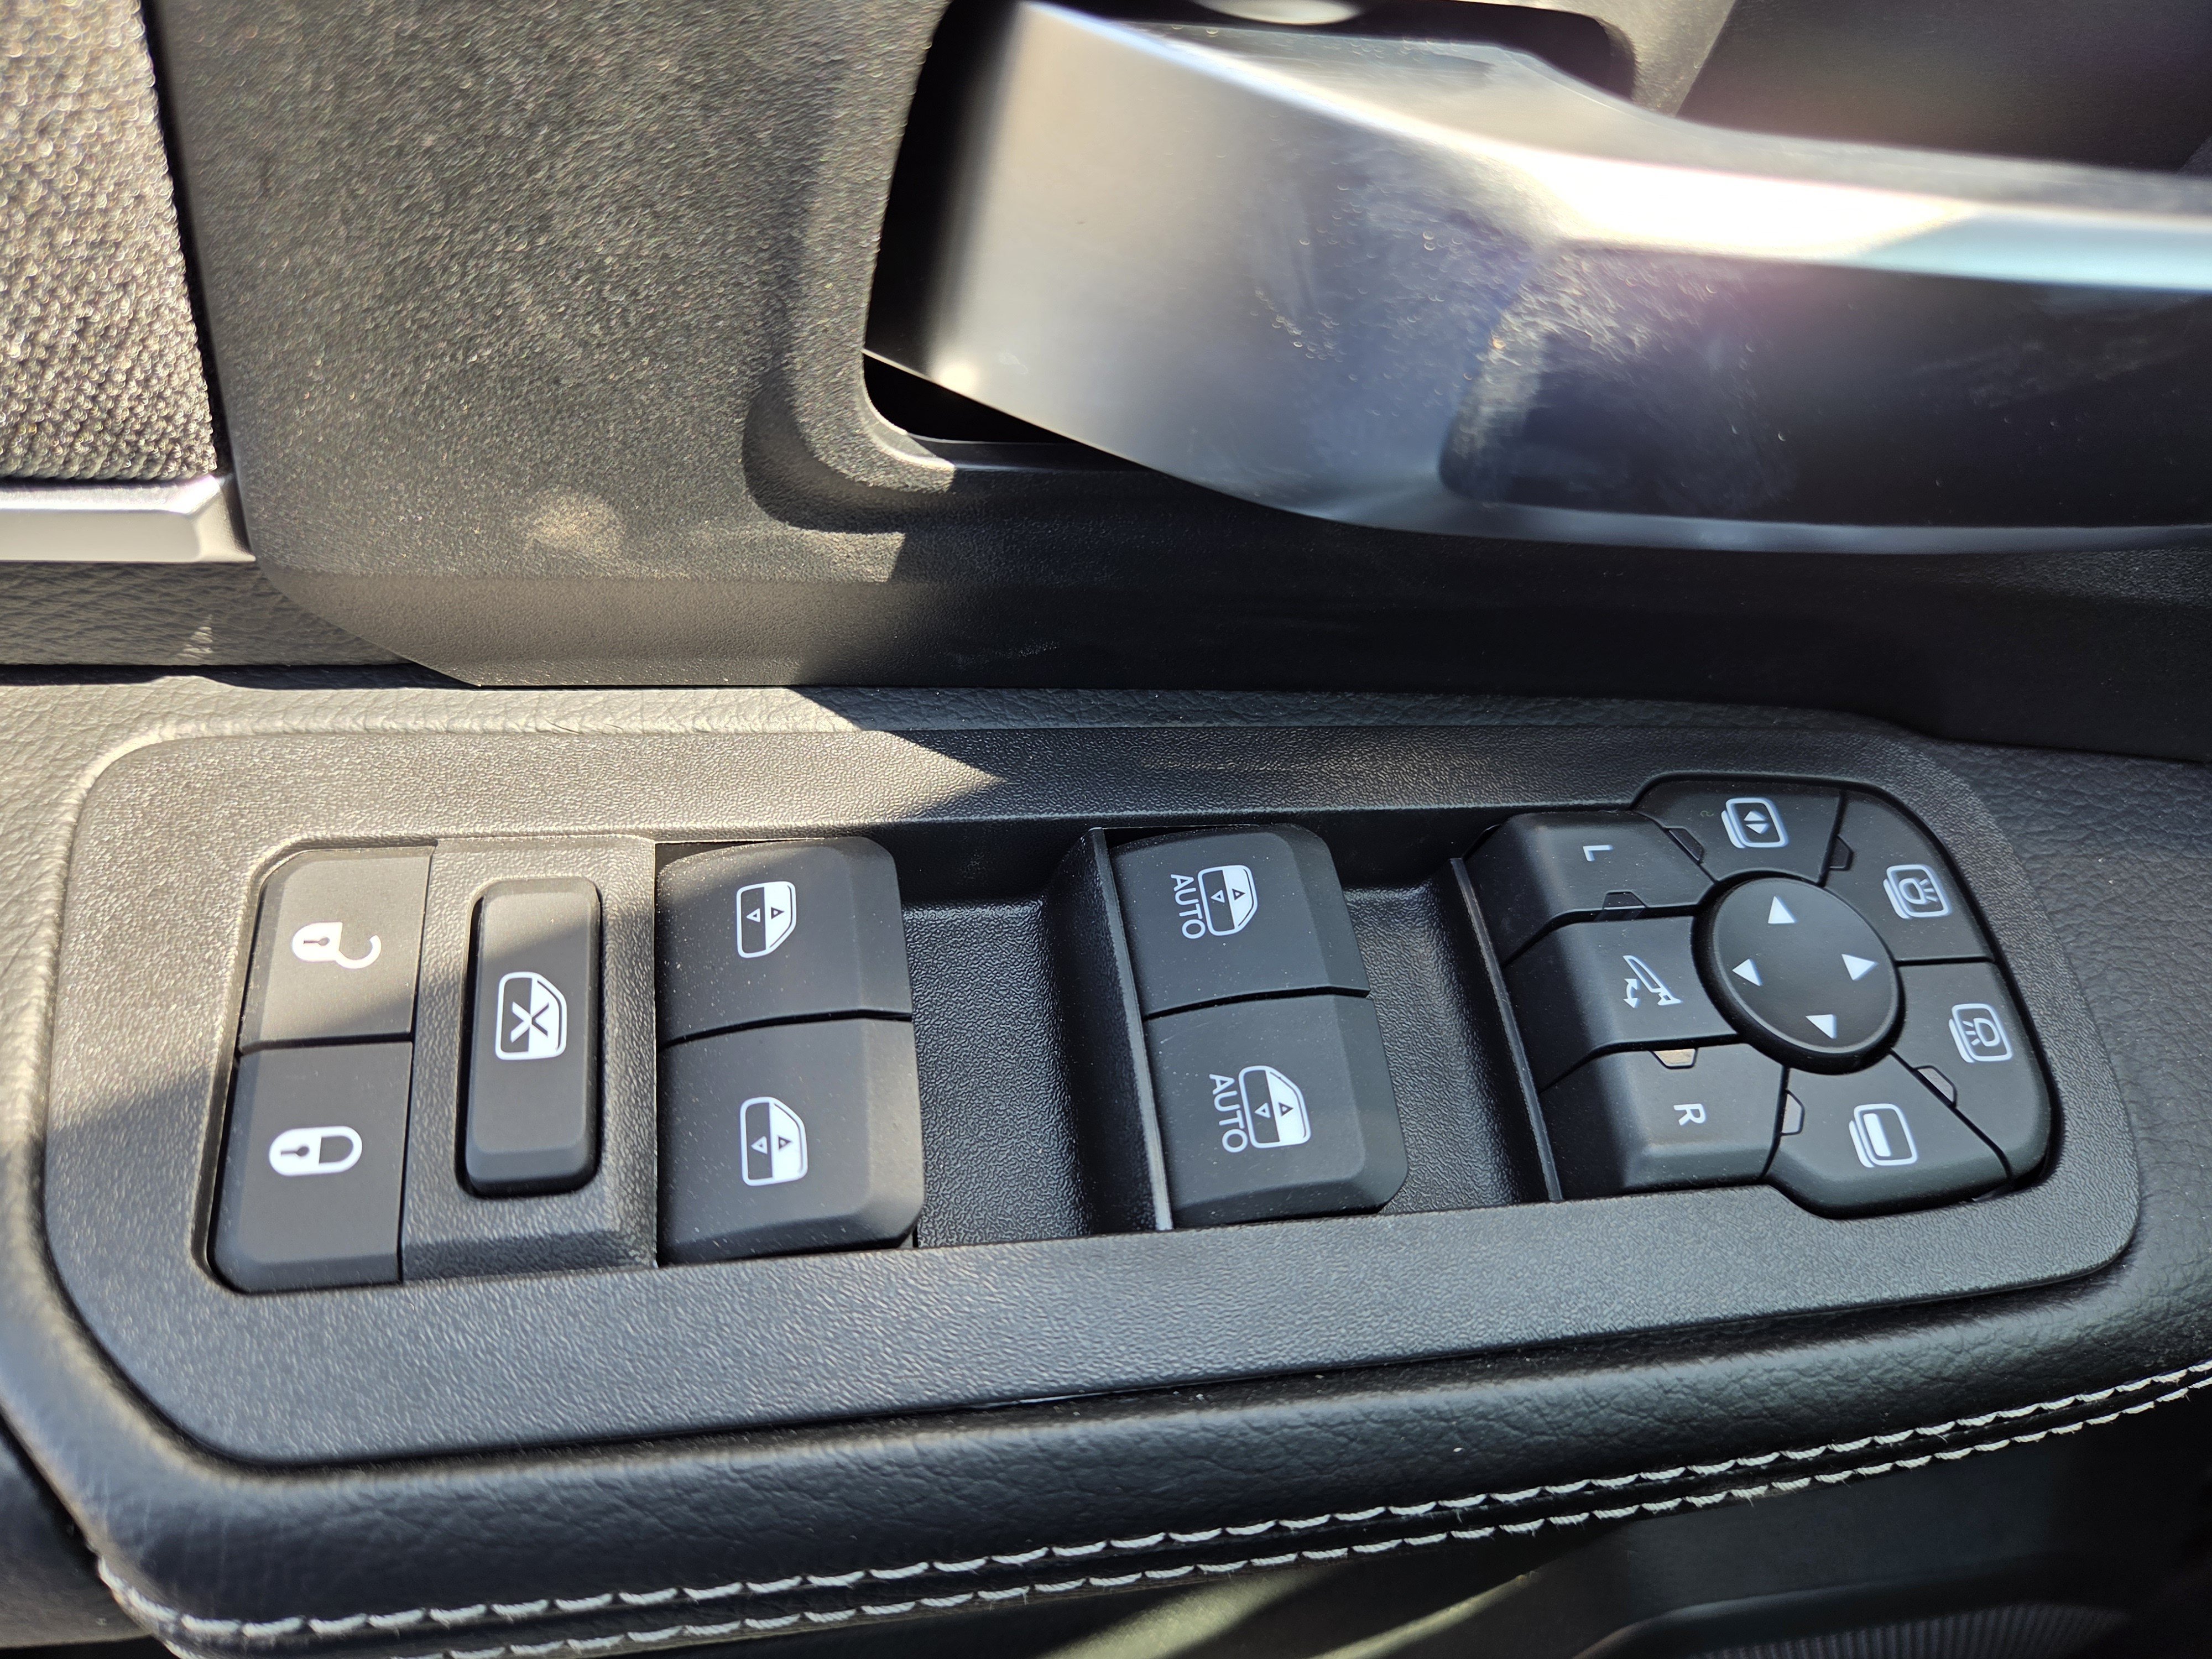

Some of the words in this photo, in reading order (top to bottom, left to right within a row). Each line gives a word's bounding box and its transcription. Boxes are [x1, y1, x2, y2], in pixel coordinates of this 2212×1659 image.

[1583, 844, 1613, 862] L
[1170, 874, 1206, 940] AUTO
[1209, 1073, 1249, 1154] AUTO
[1673, 1103, 1708, 1126] R
